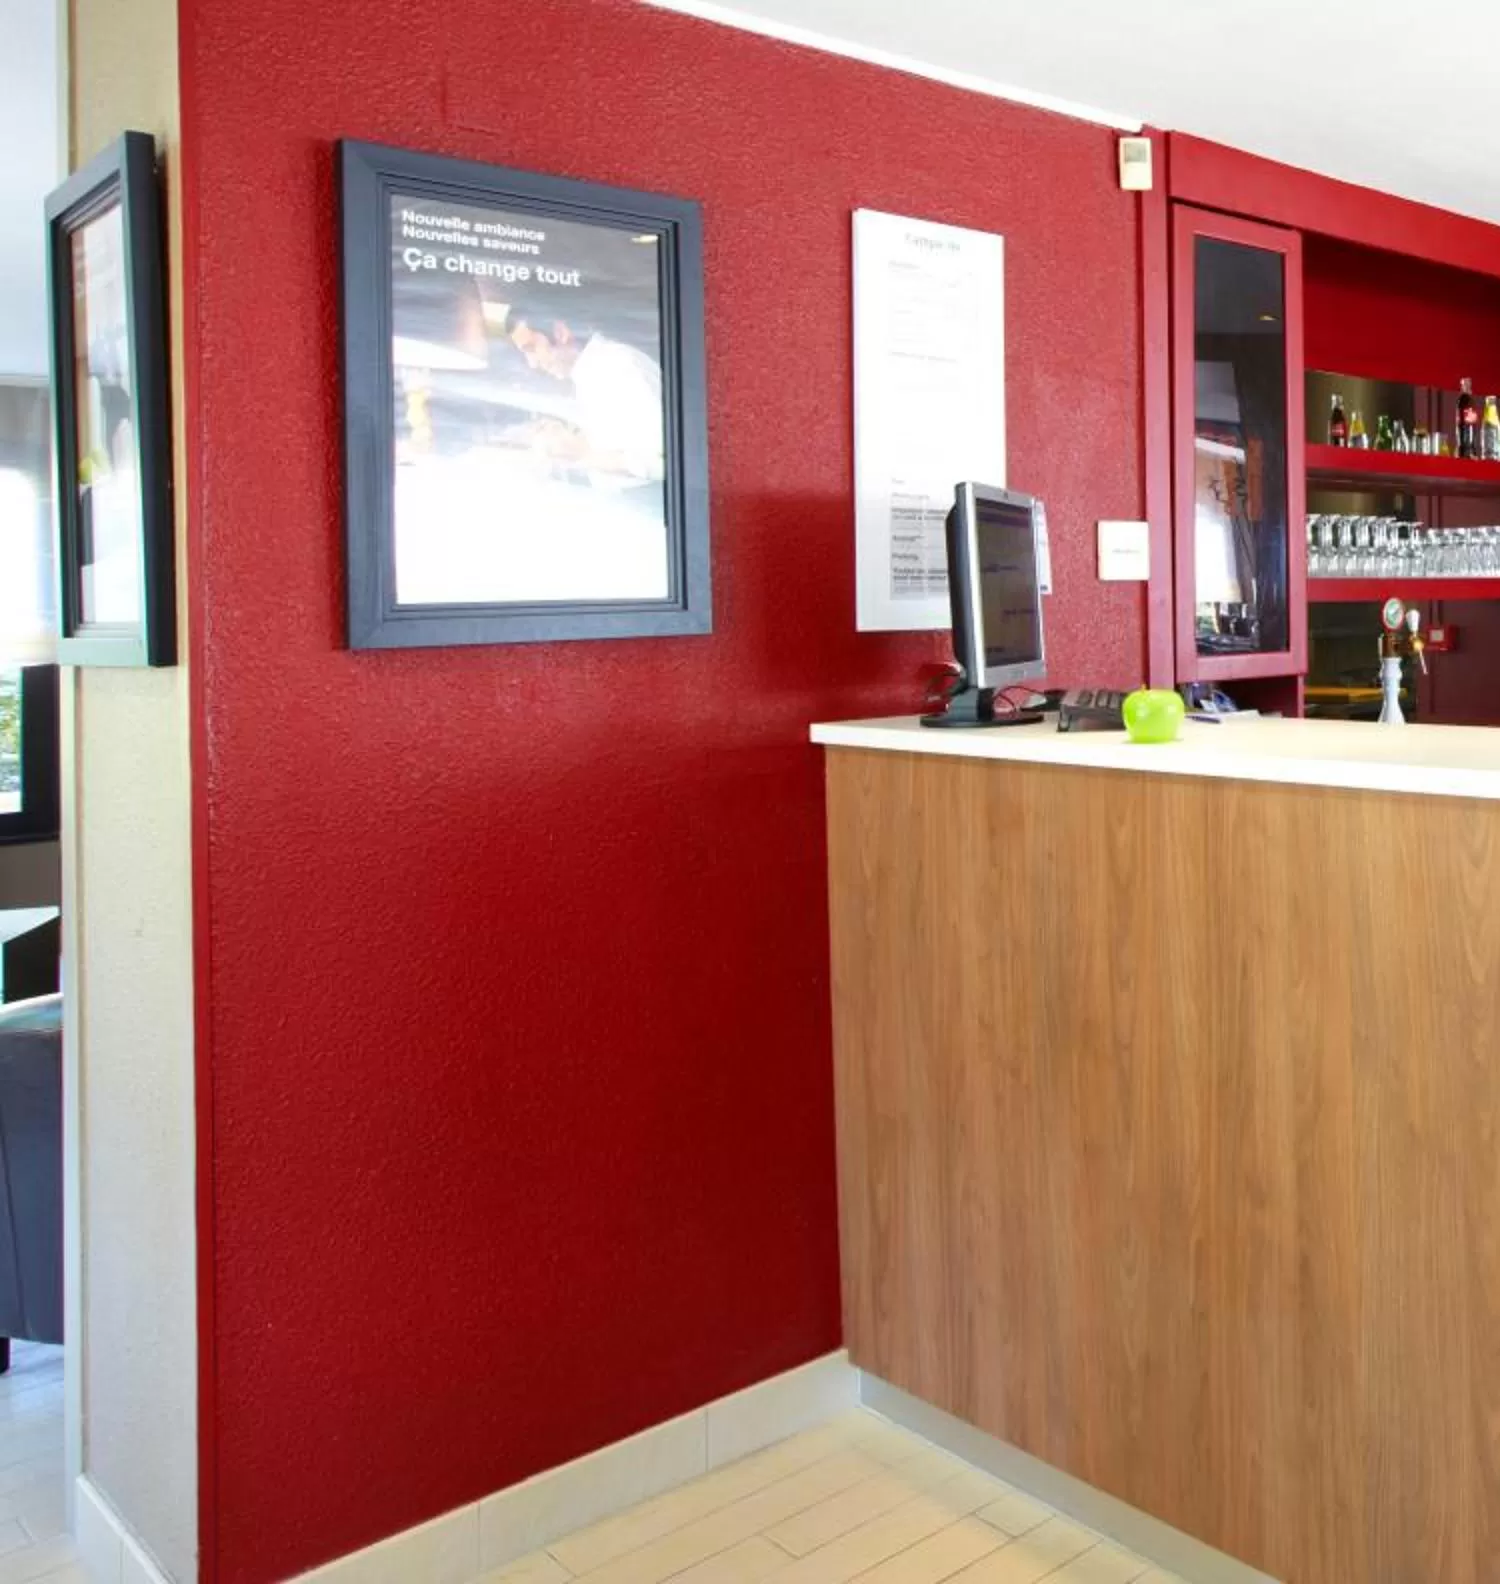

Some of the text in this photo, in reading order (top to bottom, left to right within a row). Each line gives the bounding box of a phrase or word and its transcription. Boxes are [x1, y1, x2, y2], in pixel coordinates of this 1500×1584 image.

[402, 209, 546, 241] Nouvelle ambiance
[402, 224, 540, 255] Nouvelles saveurs
[403, 247, 582, 287] Ça change tout
